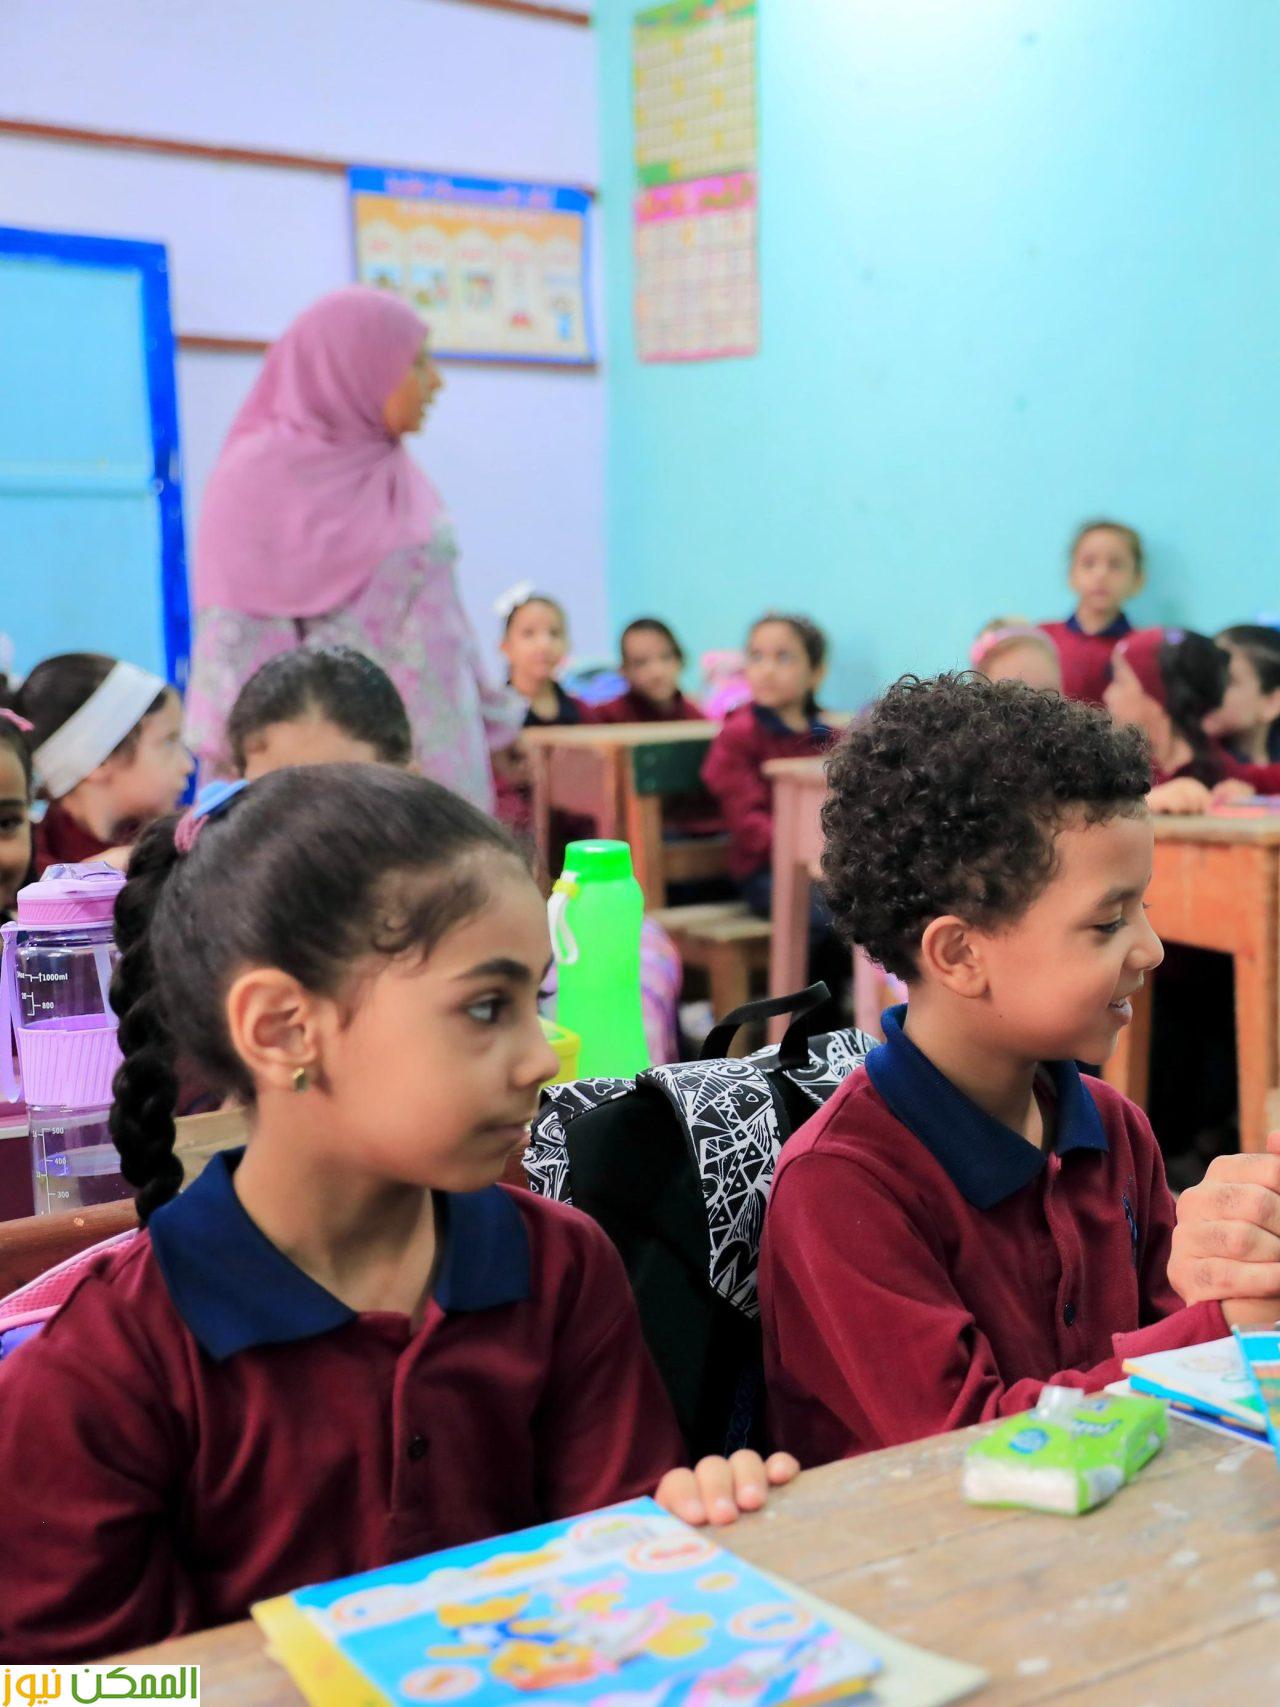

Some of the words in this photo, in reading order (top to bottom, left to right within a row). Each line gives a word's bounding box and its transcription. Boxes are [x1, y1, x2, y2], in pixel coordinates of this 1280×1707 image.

[42, 973, 68, 982] 1000ml
[41, 1001, 55, 1010] 800
[51, 1127, 65, 1135] 500
[56, 1191, 70, 1199] 300
